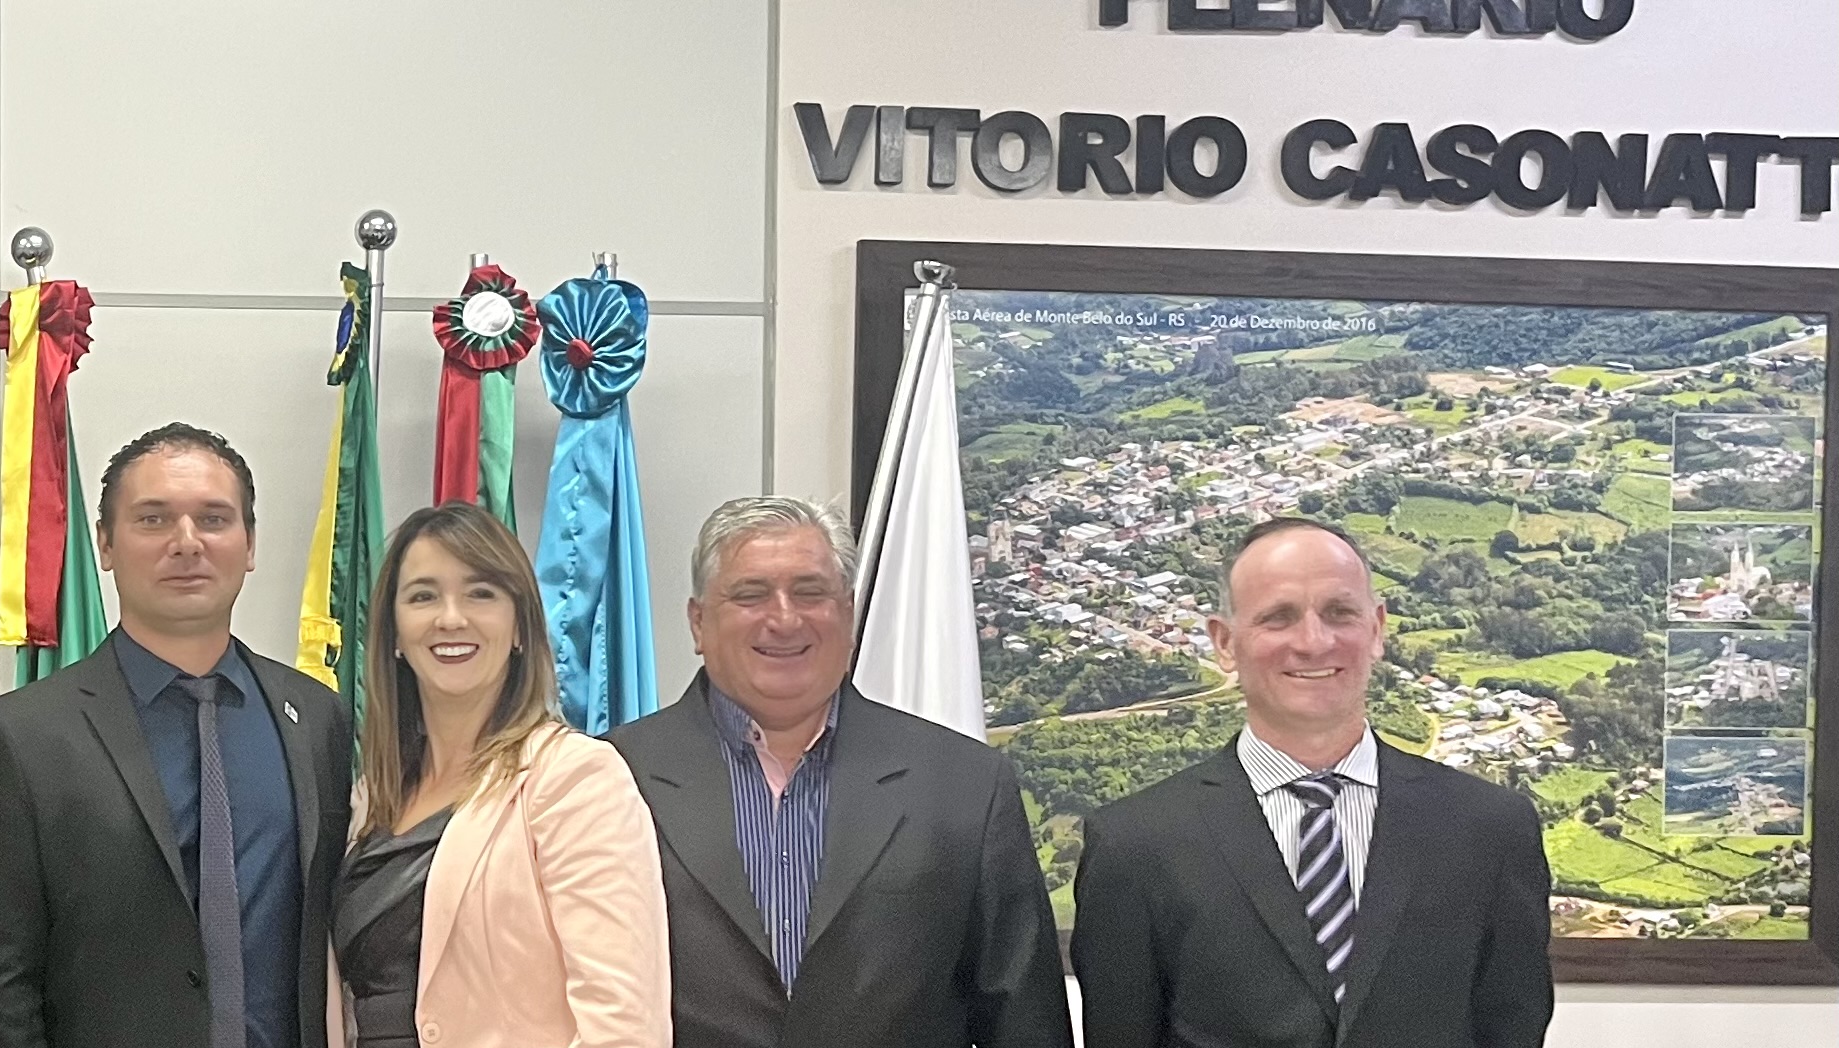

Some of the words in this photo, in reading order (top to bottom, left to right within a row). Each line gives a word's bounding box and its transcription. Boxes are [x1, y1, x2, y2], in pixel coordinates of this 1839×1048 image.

[793, 102, 1247, 197] VITORIO
[972, 308, 1011, 321] Aérea
[1014, 309, 1032, 322] de
[1035, 309, 1079, 324] Monte
[1082, 311, 1112, 325] Belo
[1115, 312, 1133, 325] do
[1136, 312, 1158, 326] Sul
[1168, 313, 1185, 326] RS
[1210, 315, 1228, 328] 20
[1229, 315, 1247, 328] de
[1250, 315, 1319, 330] Dezembro
[1322, 317, 1341, 330] de
[1343, 317, 1376, 331] 2016
